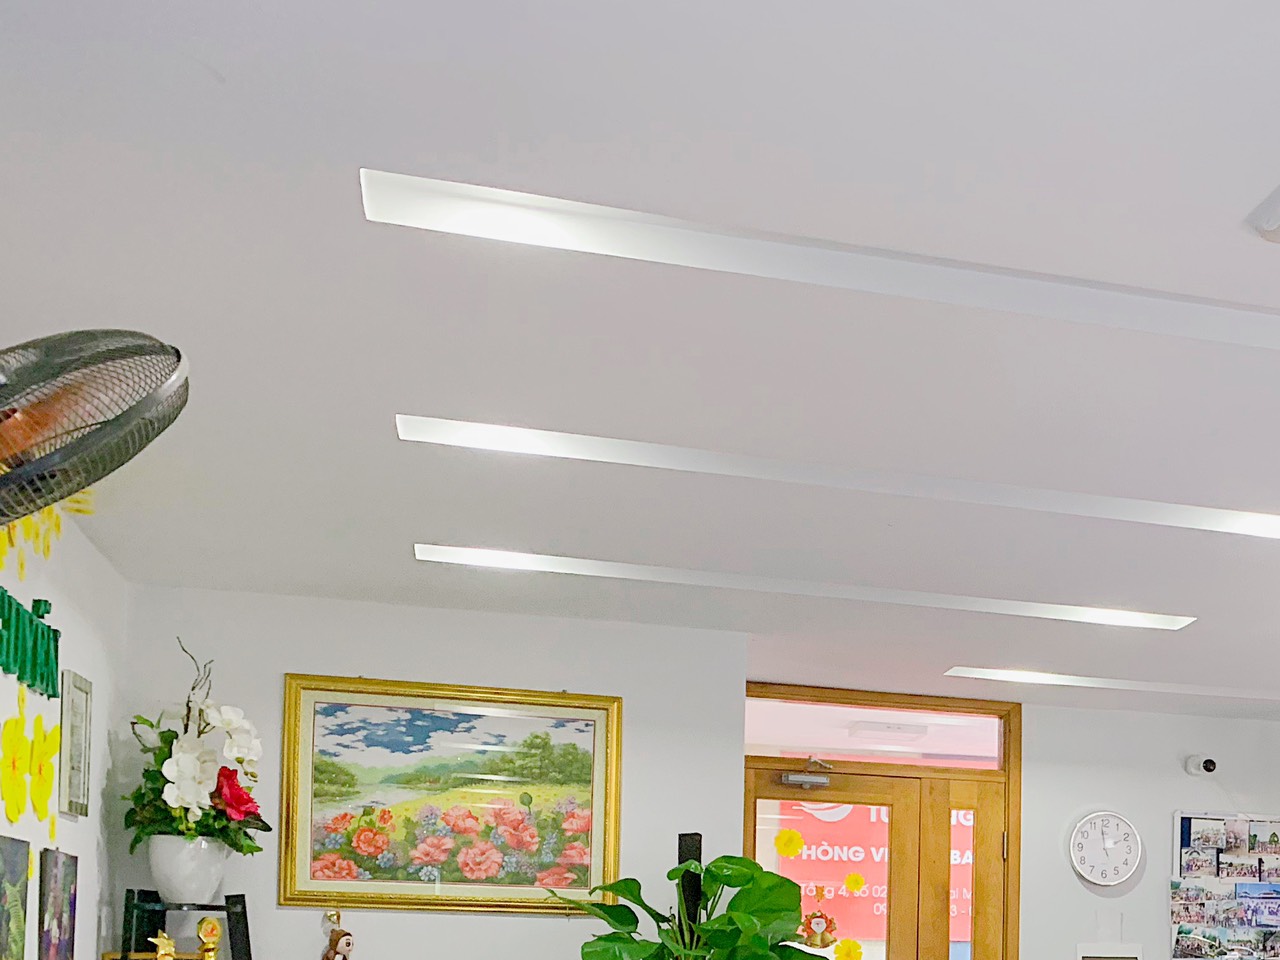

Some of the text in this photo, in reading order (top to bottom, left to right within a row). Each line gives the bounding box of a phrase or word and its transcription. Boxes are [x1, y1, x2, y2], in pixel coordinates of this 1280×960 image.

[1089, 821, 1096, 831] 11
[1101, 818, 1110, 828] 12
[1116, 823, 1120, 832] 1
[1080, 830, 1089, 840] 10
[1123, 832, 1130, 842] 2
[792, 841, 865, 862] HÒNG
[1077, 842, 1084, 852] 9
[1125, 845, 1132, 855] 3
[1079, 856, 1086, 865] 8
[1122, 858, 1128, 866] 4
[1089, 865, 1095, 874] 7
[1101, 869, 1107, 879] 6
[1113, 866, 1120, 875] 5
